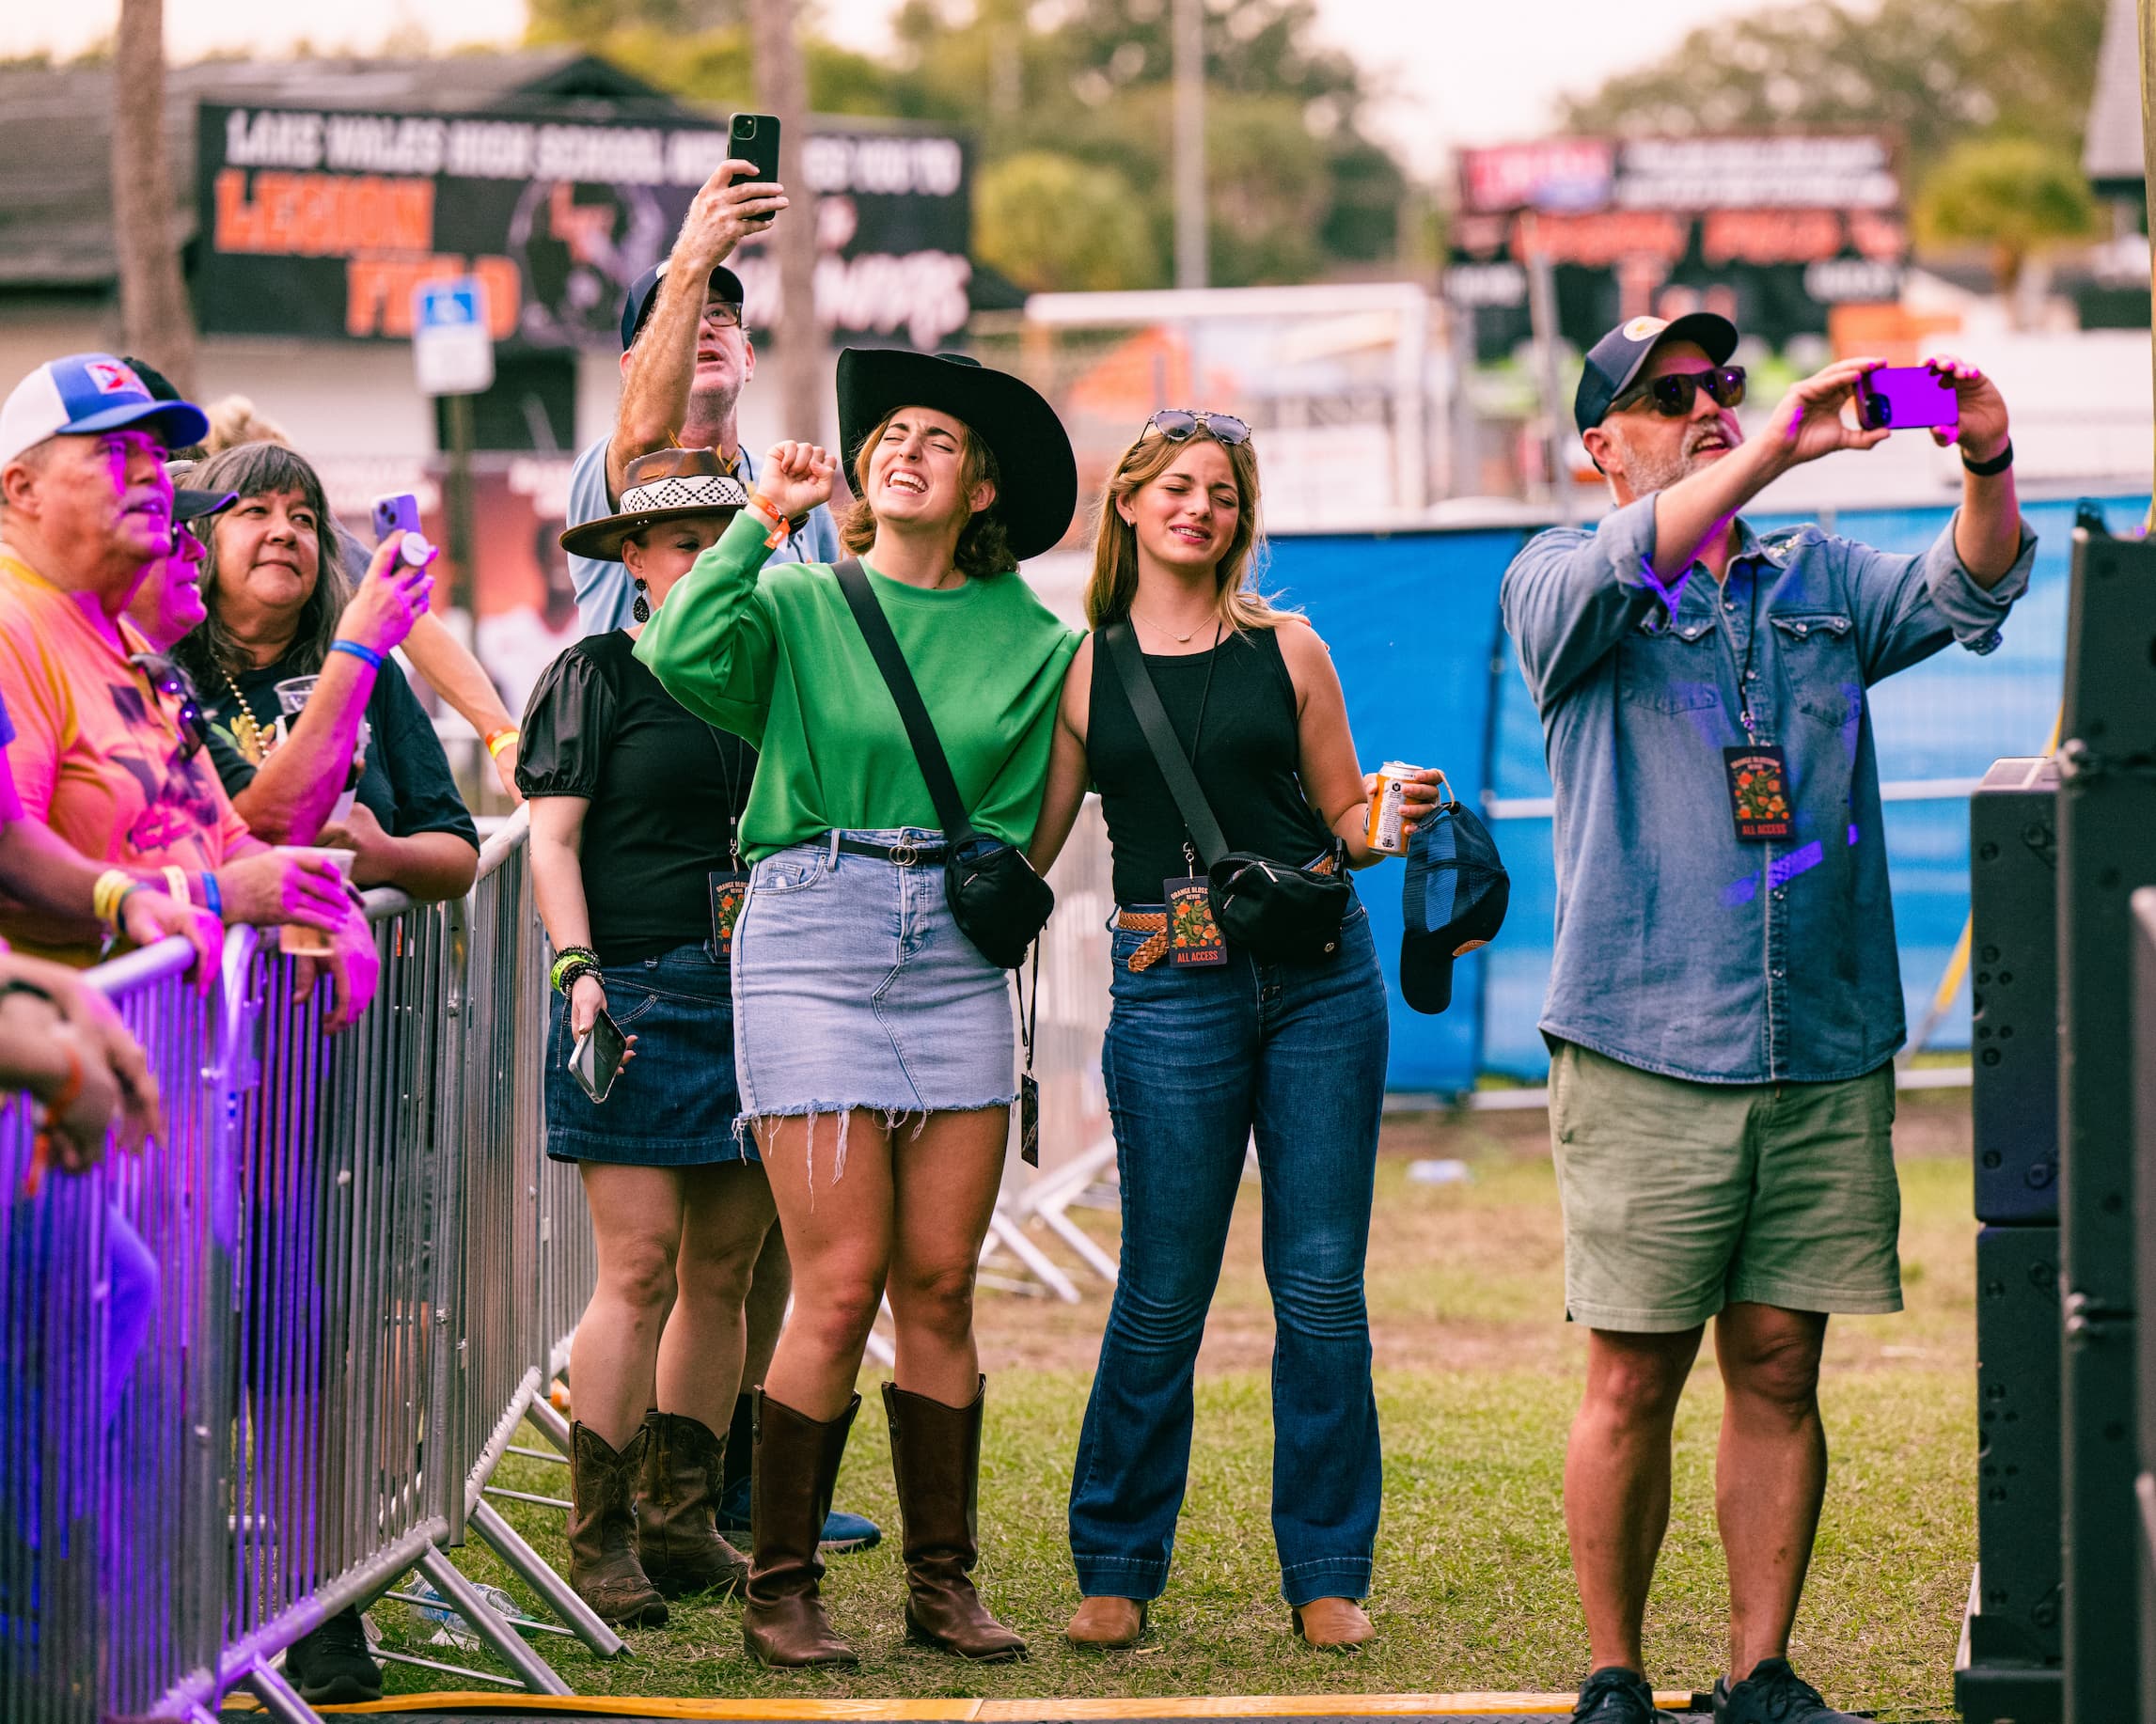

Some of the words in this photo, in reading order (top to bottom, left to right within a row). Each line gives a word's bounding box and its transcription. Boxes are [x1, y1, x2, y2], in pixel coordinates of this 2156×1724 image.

[214, 167, 435, 257] LEGION
[1171, 887, 1191, 900] ORANGE
[1177, 953, 1189, 963] ALL
[1191, 951, 1219, 962] ACCESS
